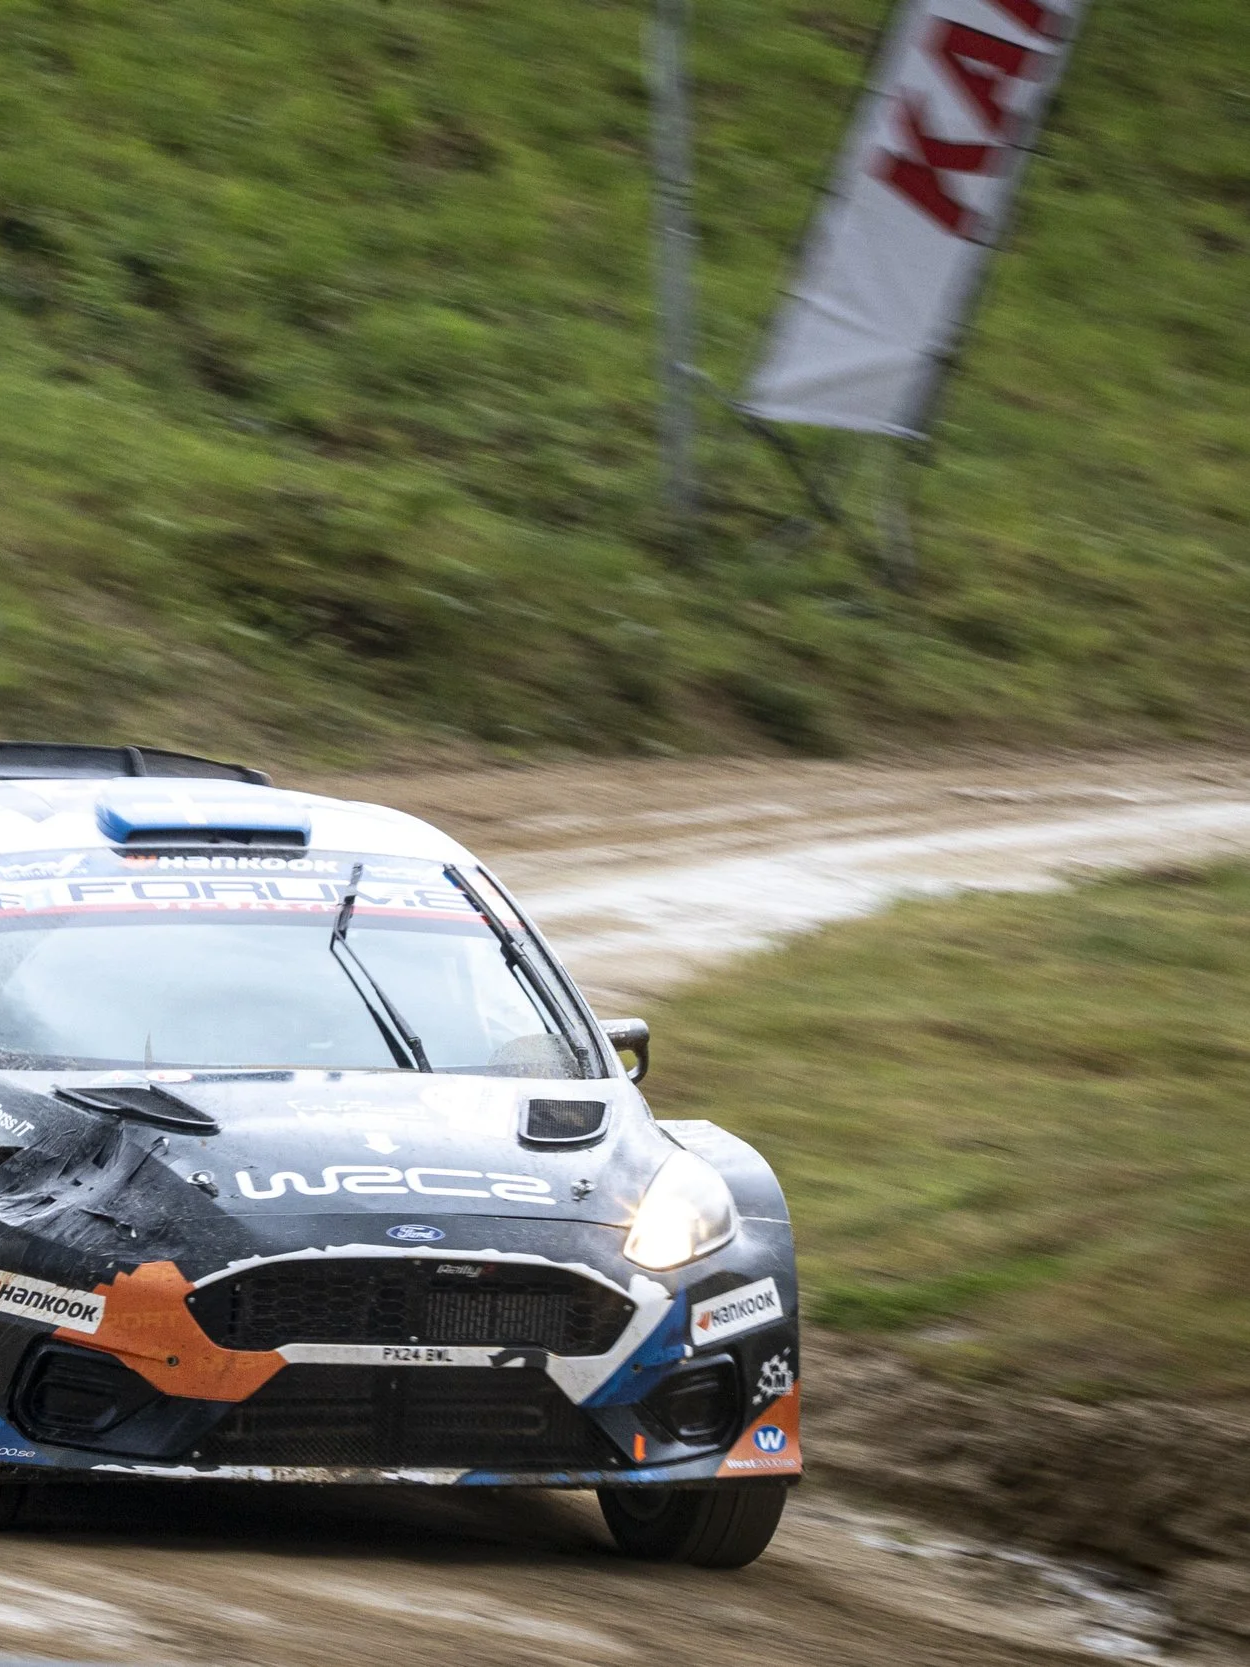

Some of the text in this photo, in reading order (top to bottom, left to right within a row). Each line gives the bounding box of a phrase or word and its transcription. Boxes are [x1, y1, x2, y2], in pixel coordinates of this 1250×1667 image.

[11, 1119, 36, 1137] IT
[235, 1165, 557, 1205] WRC2
[396, 1224, 436, 1239] Ford
[757, 1428, 785, 1450] W
